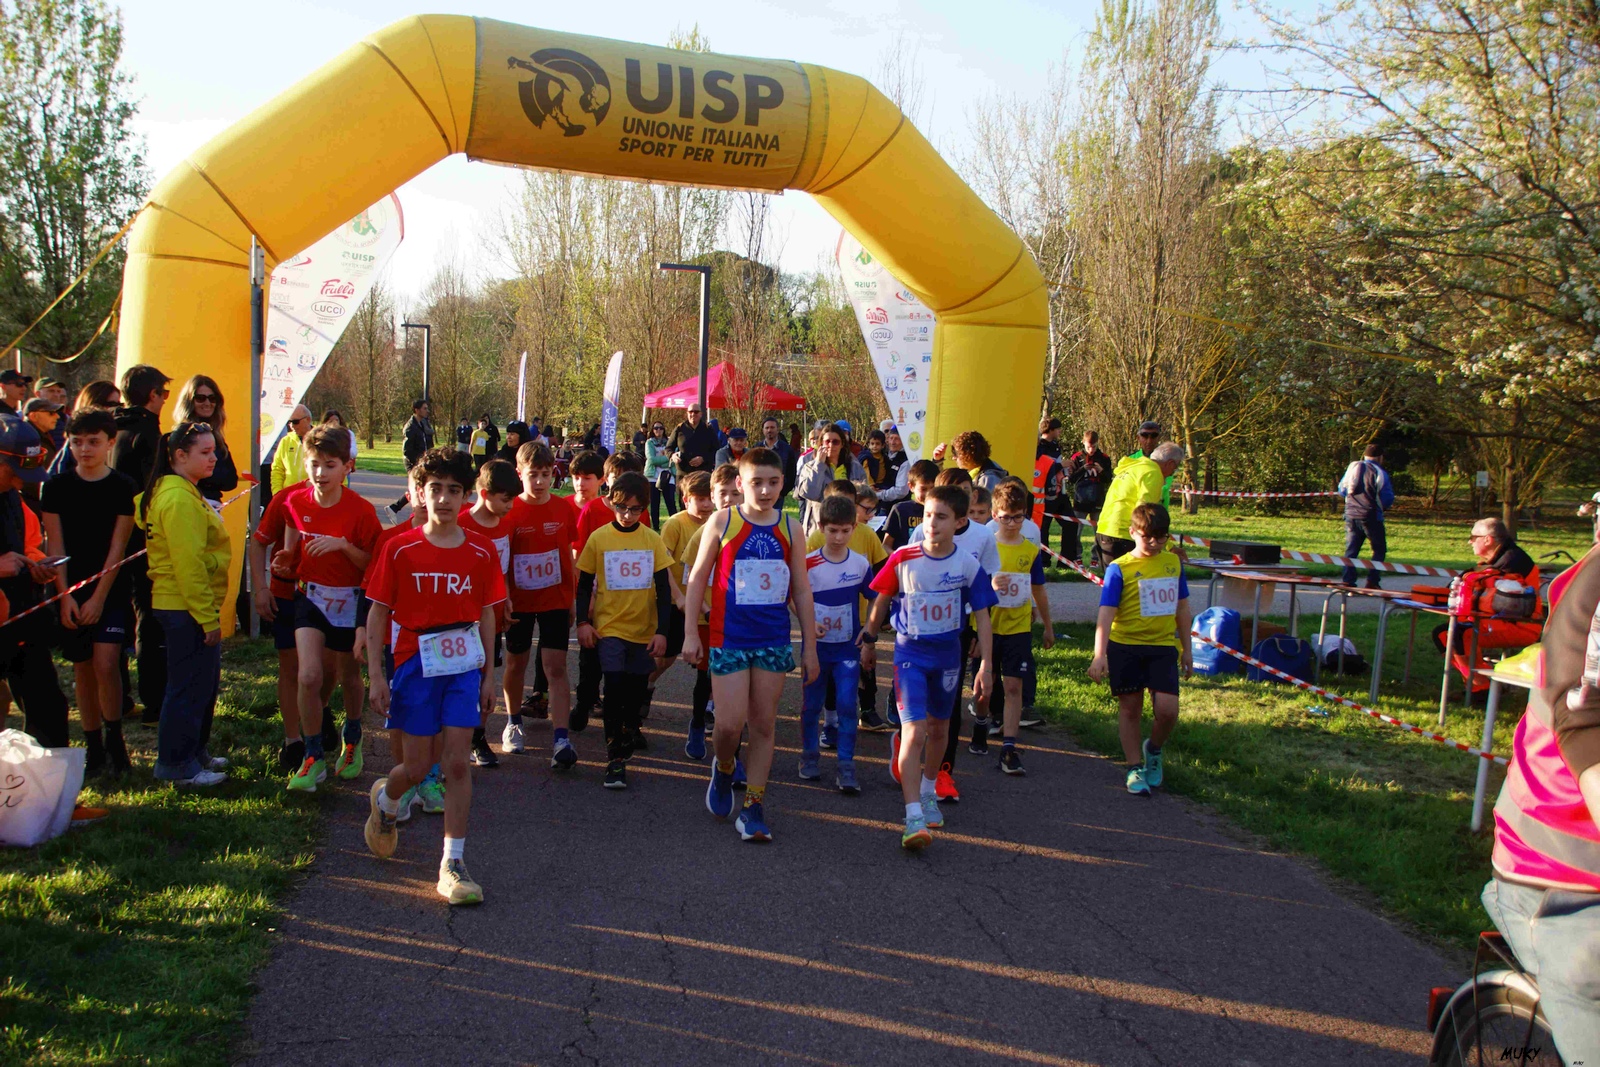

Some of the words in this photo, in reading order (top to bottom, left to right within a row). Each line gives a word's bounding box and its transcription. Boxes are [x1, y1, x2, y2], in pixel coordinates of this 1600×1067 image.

[625, 58, 784, 127] UISP
[622, 117, 693, 143] UNIONE
[701, 127, 780, 151] ITALIANA
[618, 137, 678, 160] SPORT
[682, 146, 713, 163] PER
[723, 150, 768, 168] TUTTI
[351, 252, 376, 263] UISP
[314, 305, 343, 315] LUCCI
[525, 561, 554, 579] 110
[619, 561, 642, 577] 65
[759, 573, 771, 590] 3
[1149, 588, 1175, 604] 100
[323, 597, 347, 614] 77
[920, 603, 952, 621] 101
[441, 637, 467, 659] 88
